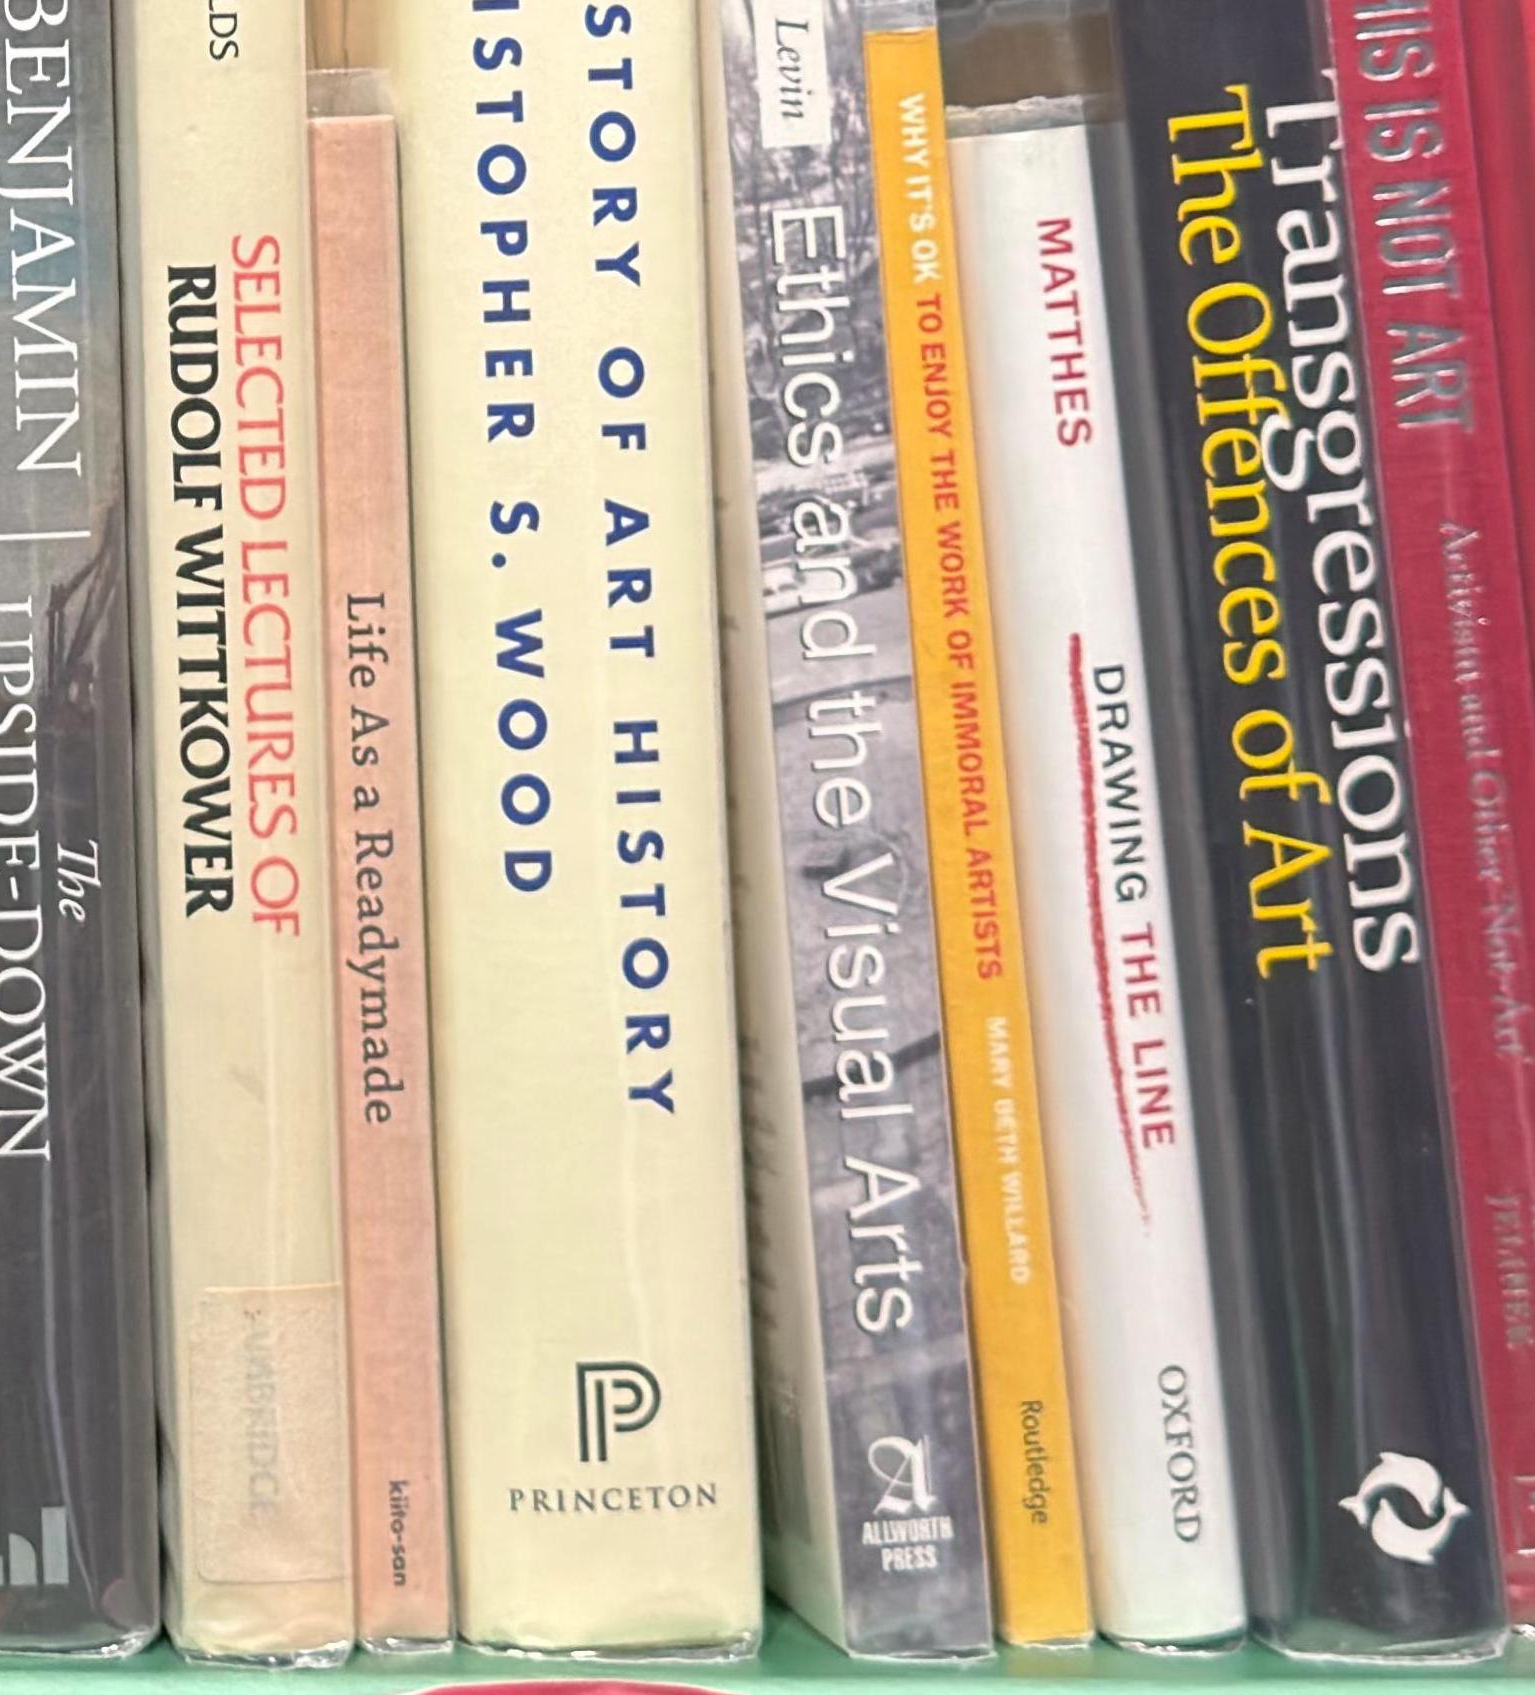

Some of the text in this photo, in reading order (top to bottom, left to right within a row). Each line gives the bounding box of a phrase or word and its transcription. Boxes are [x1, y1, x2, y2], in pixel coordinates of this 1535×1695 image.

[774, 18, 818, 122] Levin
[895, 91, 933, 162] WHY
[909, 240, 938, 284] OK
[915, 294, 943, 335] TO
[1035, 217, 1094, 450] MATTHES
[598, 346, 647, 453] OF
[918, 341, 954, 442] ENJOY
[930, 448, 958, 509] THE
[1166, 82, 1334, 980] The Offences of Art
[166, 264, 236, 921] RUDOLF WITTKOWER
[232, 233, 301, 939] SELECTED LECTURES OF
[604, 499, 654, 659] ART
[936, 517, 968, 624] WORK
[947, 629, 976, 671] OF
[771, 205, 924, 1337] Ethics and the Visual Arts
[948, 679, 992, 838] IMMORAL
[611, 718, 675, 1114] HISTORY
[963, 843, 1004, 982] ARTISTS
[1092, 663, 1178, 1150] DRAWING THE LINE
[508, 1483, 716, 1515] PRINCETON
[1017, 1399, 1049, 1527] Routledge
[1156, 1361, 1202, 1545] OXFORD
[388, 1477, 408, 1590] kiito-san
[861, 1515, 954, 1545] ALLWORTH
[881, 1543, 938, 1572] PRESS
